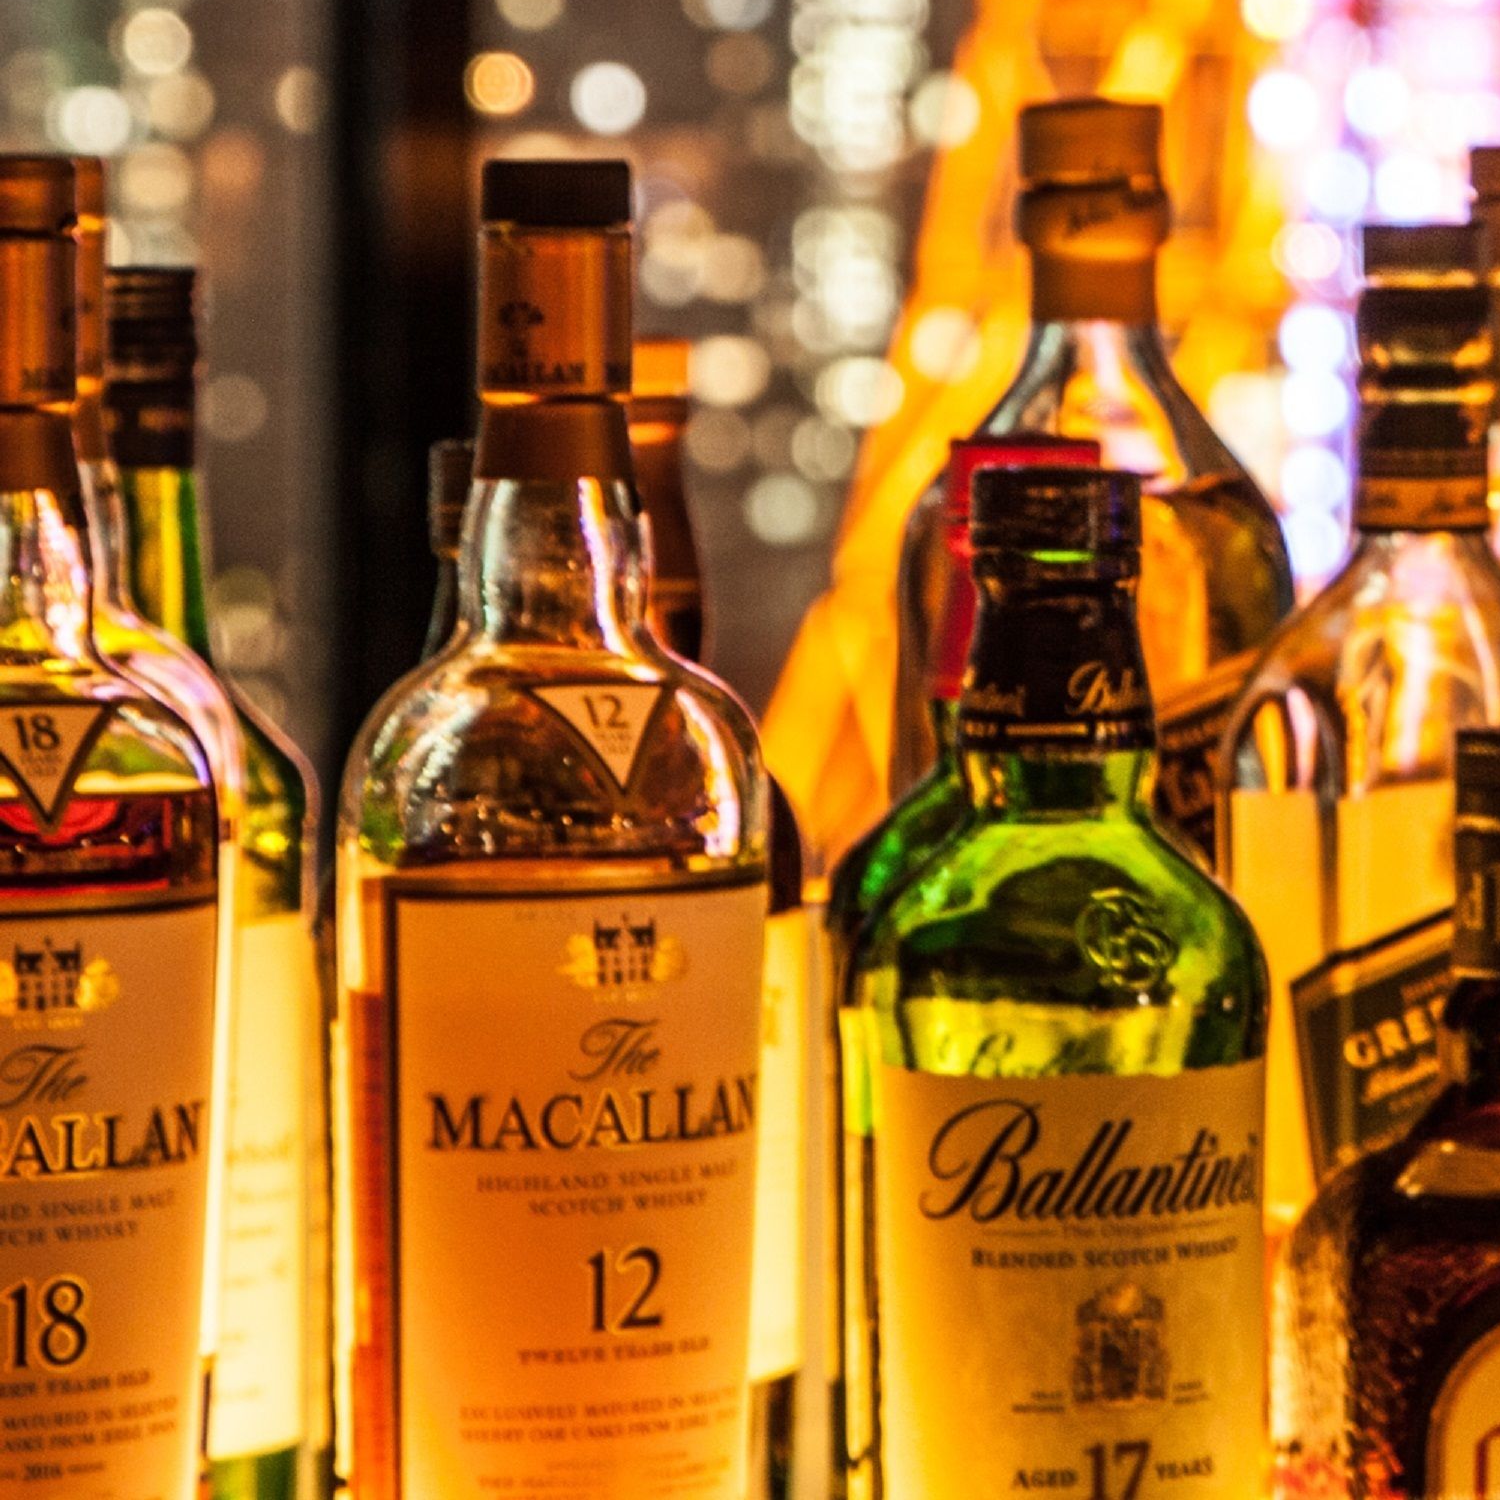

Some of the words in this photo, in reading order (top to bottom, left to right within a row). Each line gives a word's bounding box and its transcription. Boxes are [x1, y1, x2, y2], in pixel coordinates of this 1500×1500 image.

[12, 712, 61, 752] 18
[582, 694, 630, 729] 12
[567, 1017, 663, 1083] The
[2, 1100, 205, 1178] ALLAN
[427, 1071, 757, 1153] MACALLAN
[586, 1245, 664, 1334] 12
[972, 1247, 1076, 1269] BLENDED
[1084, 1245, 1170, 1268] SCOTCH
[8, 1278, 89, 1369] 18
[1012, 1467, 1078, 1490] AGED
[1083, 1439, 1152, 1500] 17
